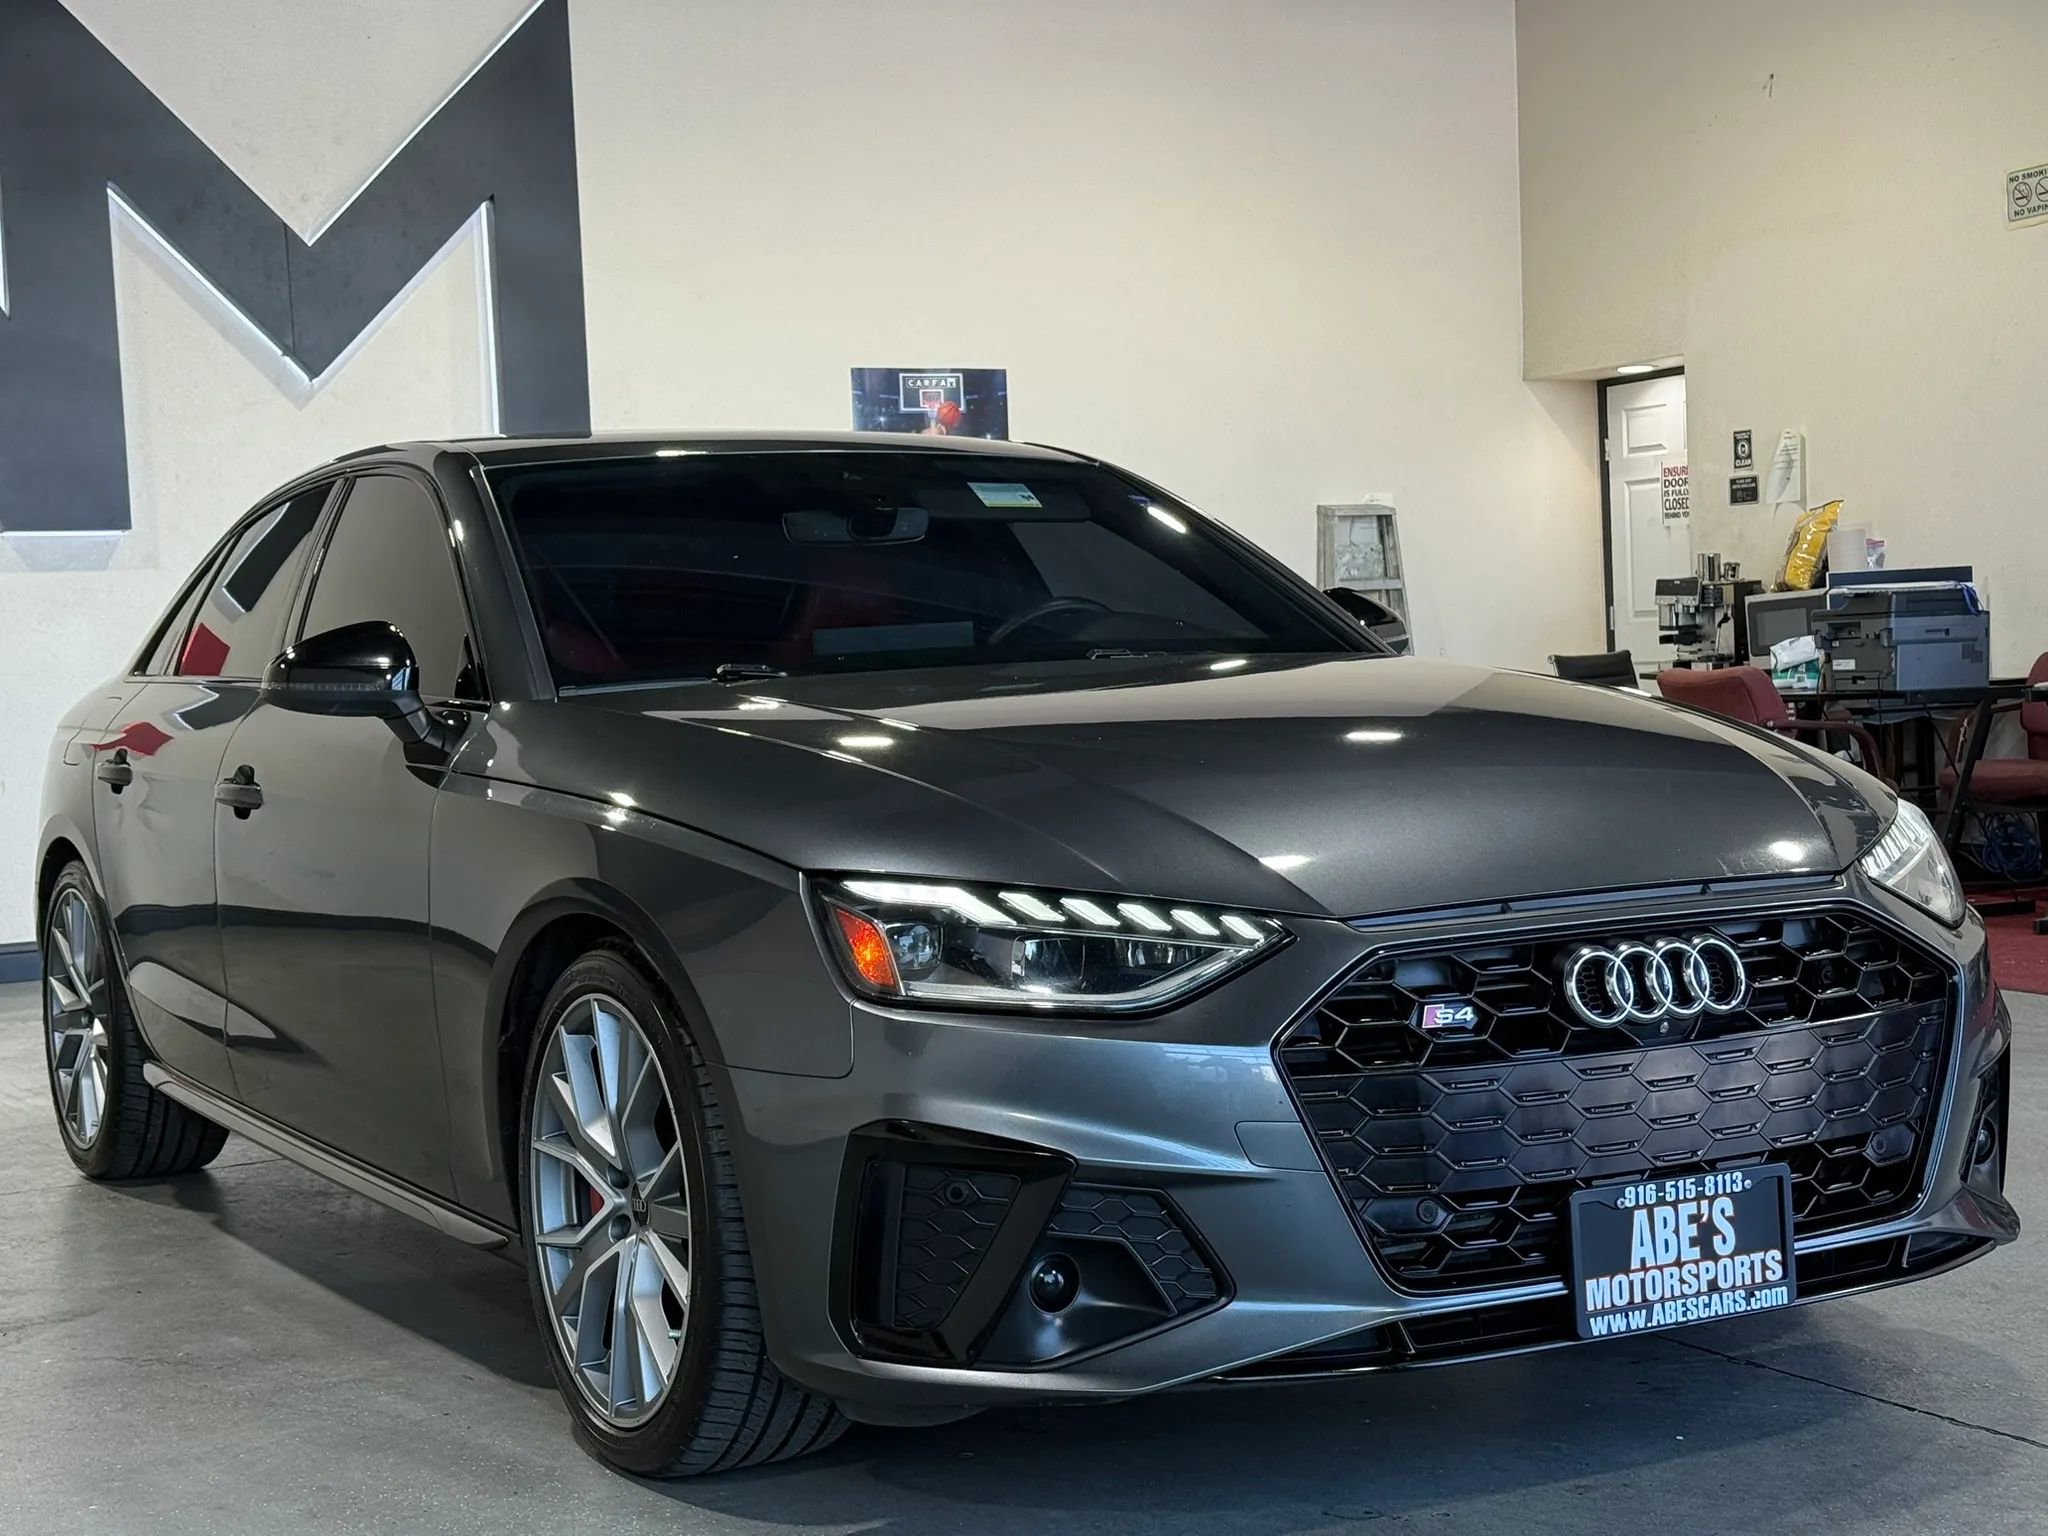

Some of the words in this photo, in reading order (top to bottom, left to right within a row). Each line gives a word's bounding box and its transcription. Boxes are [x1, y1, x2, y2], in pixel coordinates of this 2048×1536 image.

[2009, 175, 2020, 183] NO
[2021, 168, 2048, 181] SMOKI
[2014, 209, 2025, 217] NO
[1434, 1006, 1474, 1024] S4
[1624, 1171, 1743, 1207] 916-515-8113
[1630, 1197, 1736, 1270] ABE'S
[1585, 1250, 1783, 1312] MOTORSPORTS
[1590, 1286, 1788, 1336] WWW.ABESCARS.com
